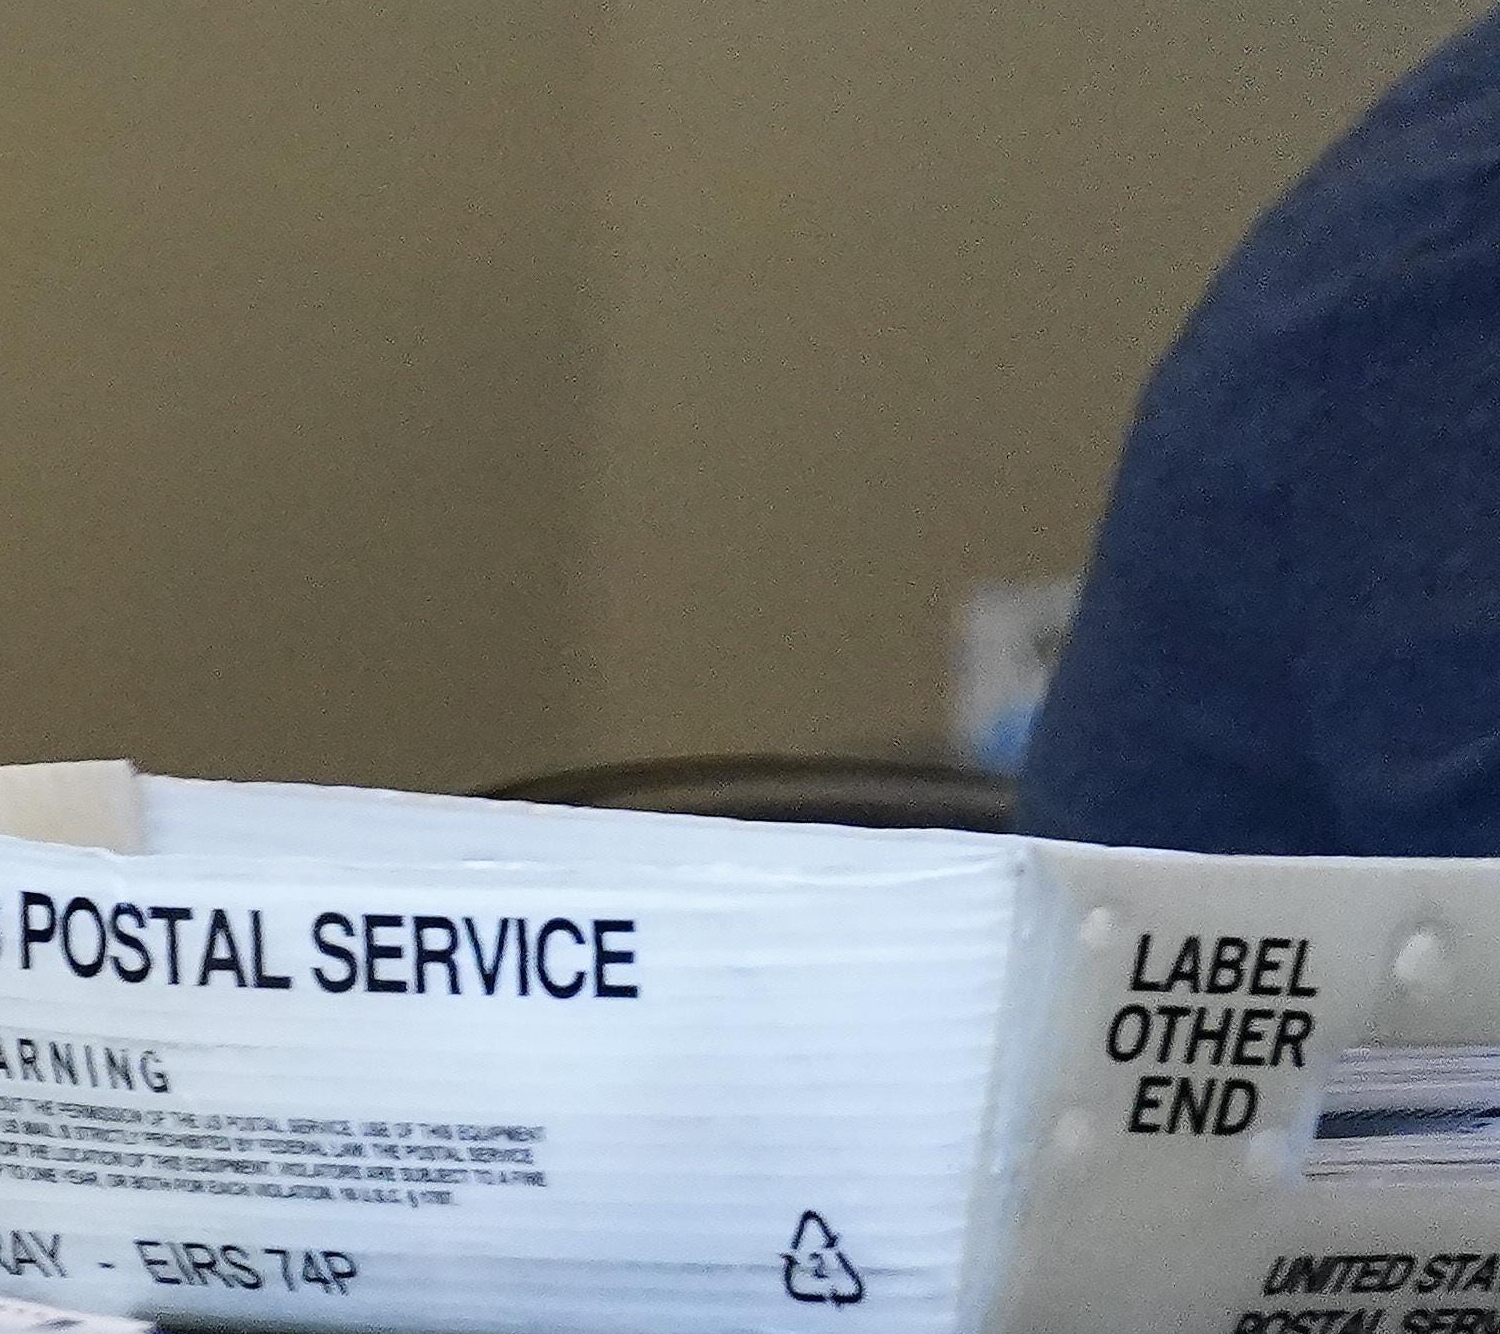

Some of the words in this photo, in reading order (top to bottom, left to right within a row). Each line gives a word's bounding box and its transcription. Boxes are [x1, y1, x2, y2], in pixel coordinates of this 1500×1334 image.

[21, 890, 293, 990] POSTAL
[311, 911, 639, 999] SERVICE
[1129, 933, 1319, 998] LABEL
[1106, 1003, 1314, 1068] OTHER
[1128, 1075, 1259, 1135] END
[134, 1240, 263, 1291] EIRS
[263, 1248, 358, 1296] 74P
[1261, 1254, 1416, 1297] UNITED
[1415, 1253, 1500, 1294] STA
